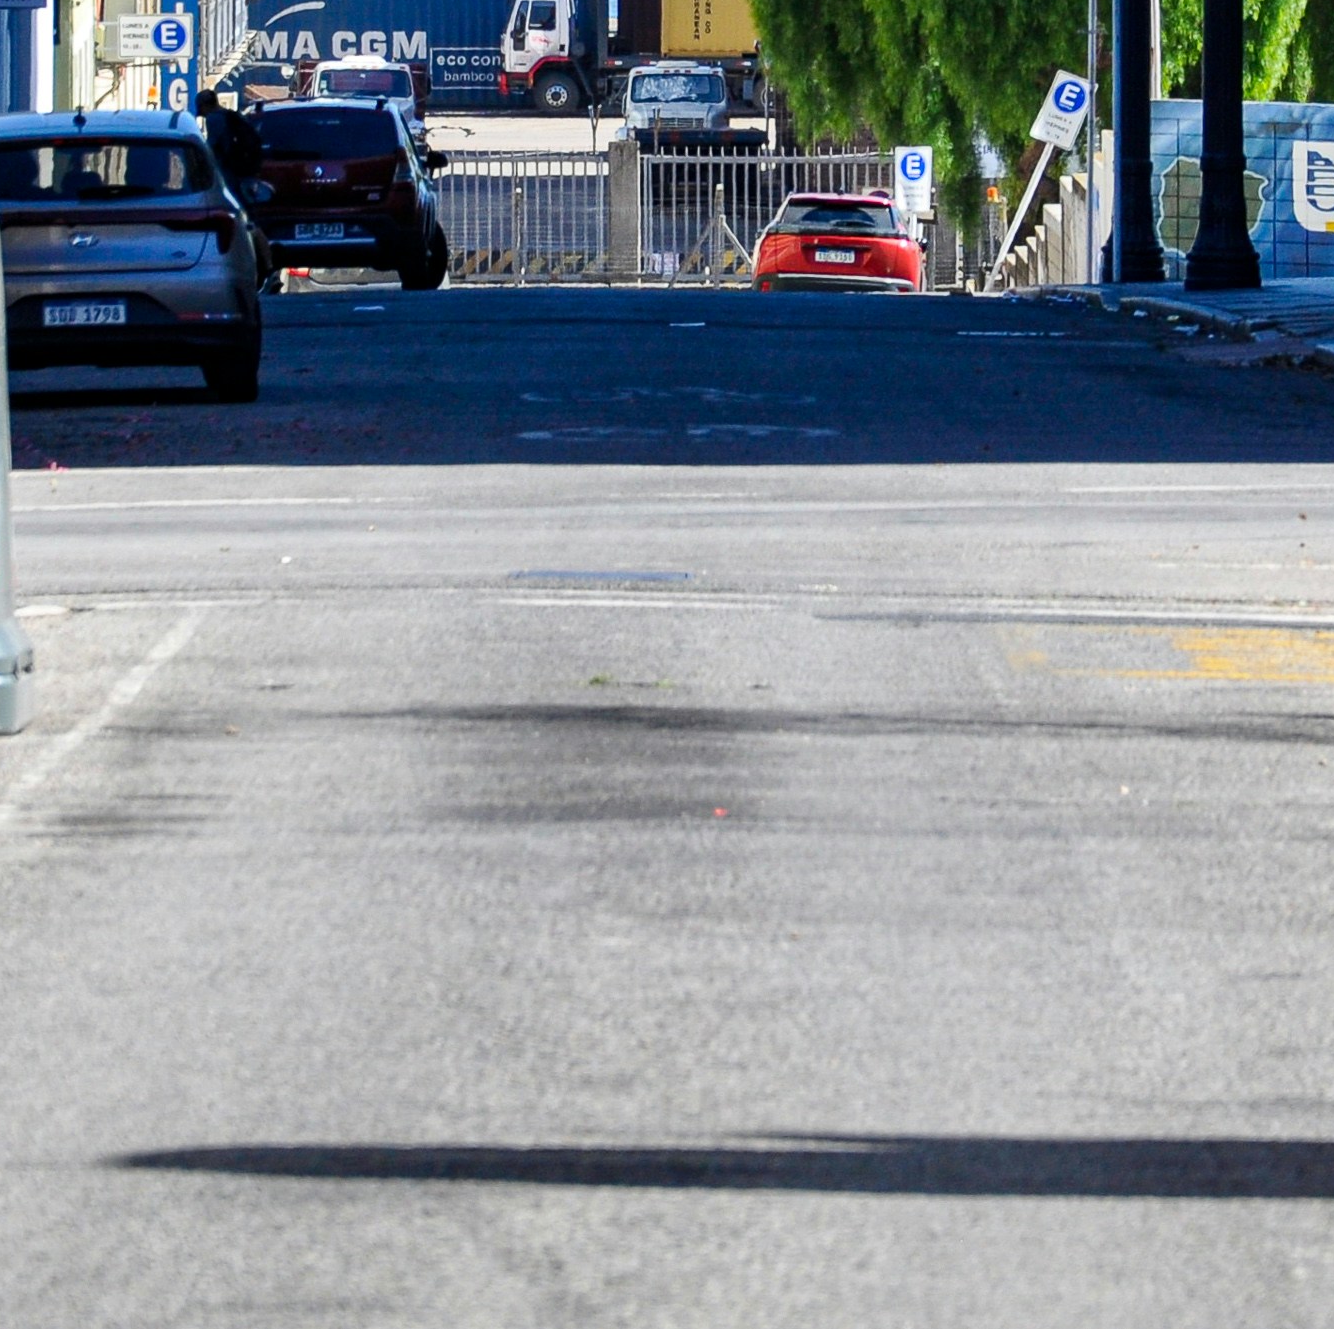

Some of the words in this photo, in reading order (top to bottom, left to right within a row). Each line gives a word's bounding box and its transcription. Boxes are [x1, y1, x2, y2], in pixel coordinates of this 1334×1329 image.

[160, 23, 178, 45] E
[257, 31, 321, 60] MA
[331, 30, 427, 60] CGM
[436, 53, 467, 66] eco
[443, 70, 495, 82] bamboo
[1059, 83, 1081, 108] E
[906, 153, 921, 176] E
